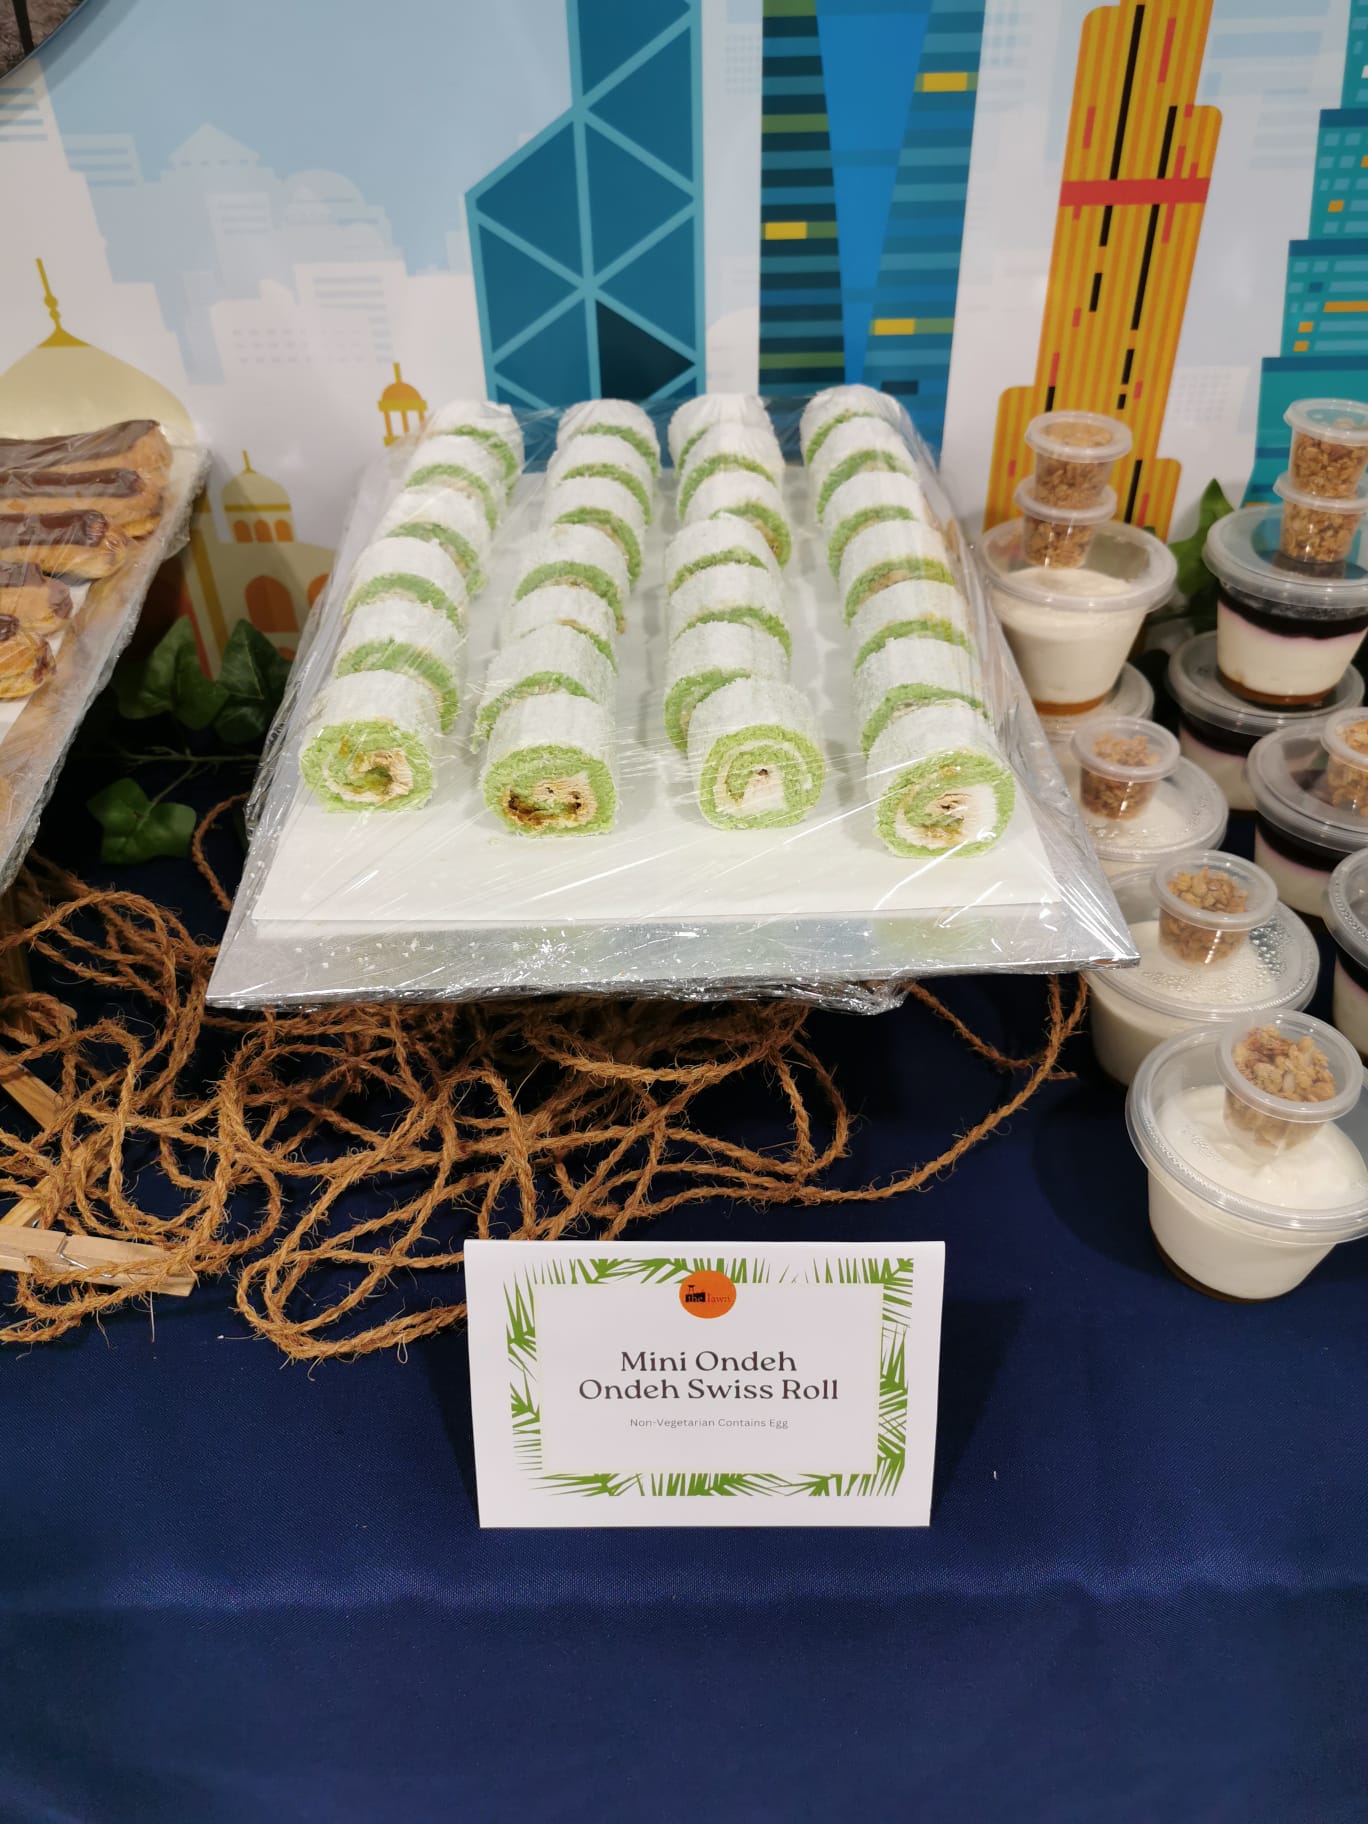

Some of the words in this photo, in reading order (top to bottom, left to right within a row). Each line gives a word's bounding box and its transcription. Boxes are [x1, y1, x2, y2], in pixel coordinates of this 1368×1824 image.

[621, 1351, 687, 1371] Mini
[695, 1350, 797, 1372] Ondeh
[579, 1379, 680, 1400] Ondeh
[687, 1379, 774, 1400] Swiss
[781, 1379, 838, 1400] Roll
[630, 1418, 715, 1429] Non-Vegetarian
[718, 1418, 766, 1428] Contains
[769, 1419, 788, 1429] Egg
